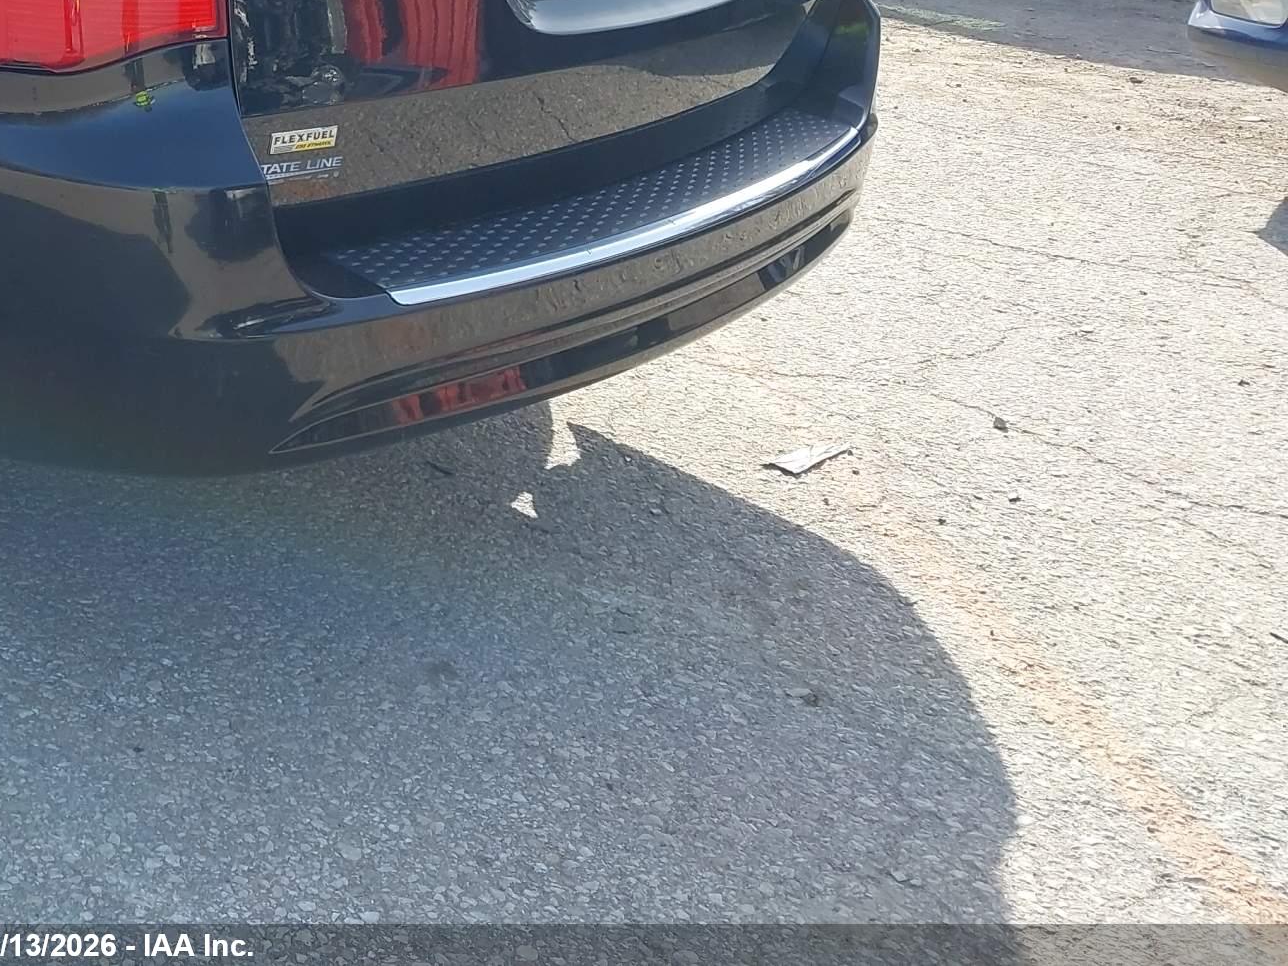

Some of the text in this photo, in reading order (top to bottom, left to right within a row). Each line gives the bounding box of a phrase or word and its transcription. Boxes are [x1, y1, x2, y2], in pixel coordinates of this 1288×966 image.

[273, 130, 335, 145] FLEXFUEL
[261, 156, 344, 175] TATE LINE
